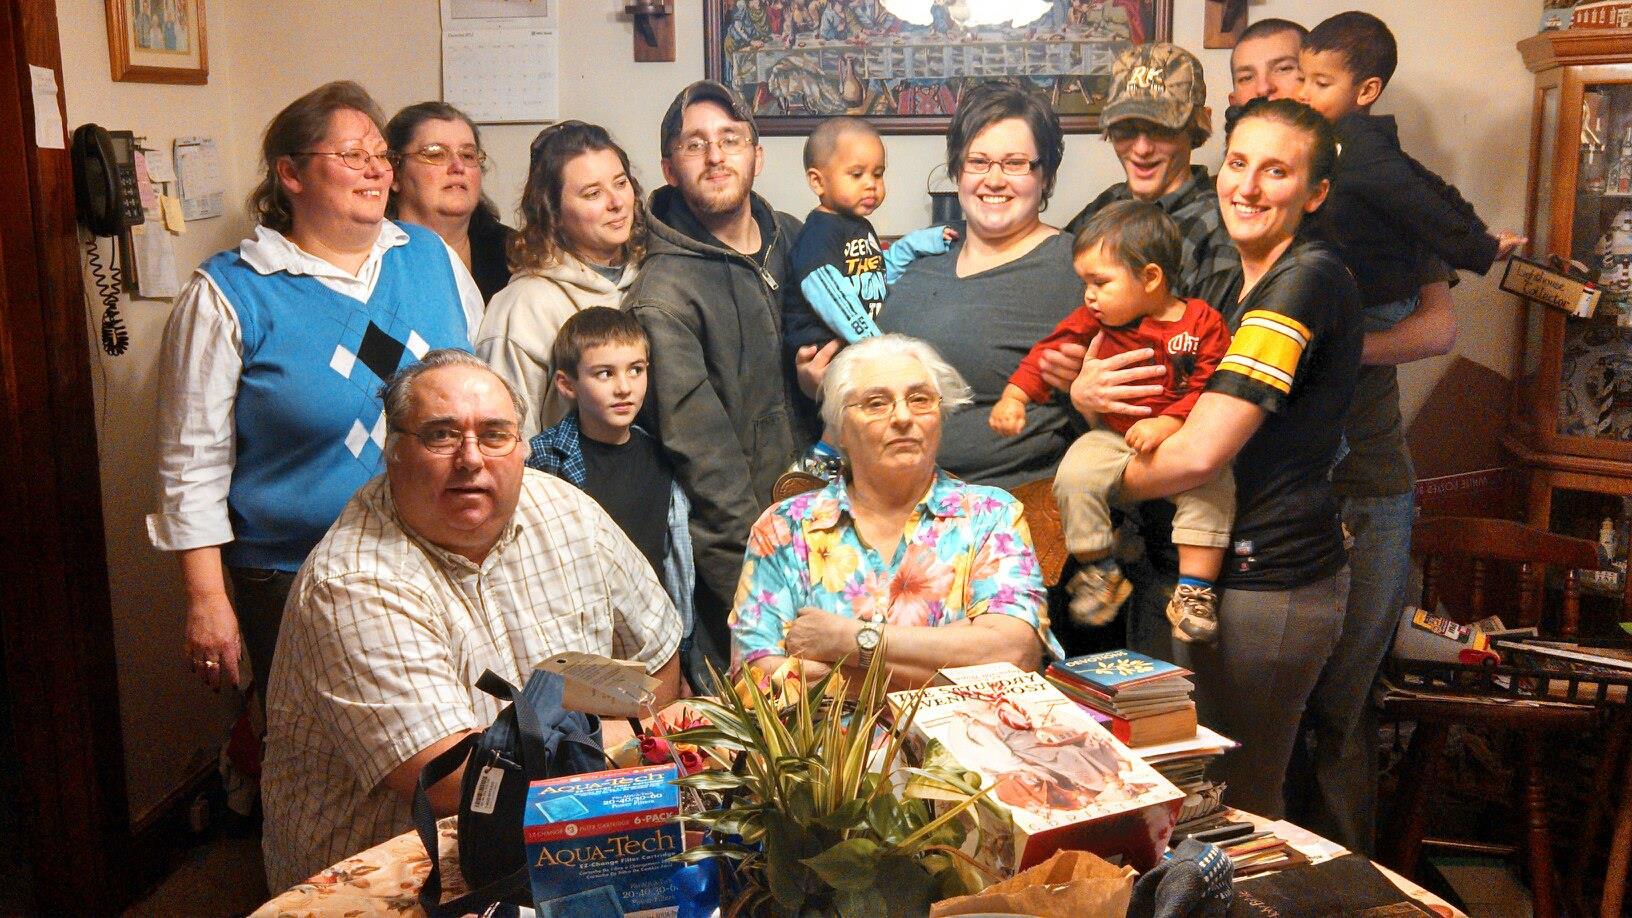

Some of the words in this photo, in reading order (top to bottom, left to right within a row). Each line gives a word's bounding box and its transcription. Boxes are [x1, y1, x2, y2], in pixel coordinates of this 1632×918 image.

[894, 688, 935, 702] THE
[634, 812, 673, 824] 6-PACK
[534, 830, 675, 867] AQUA-Tech
